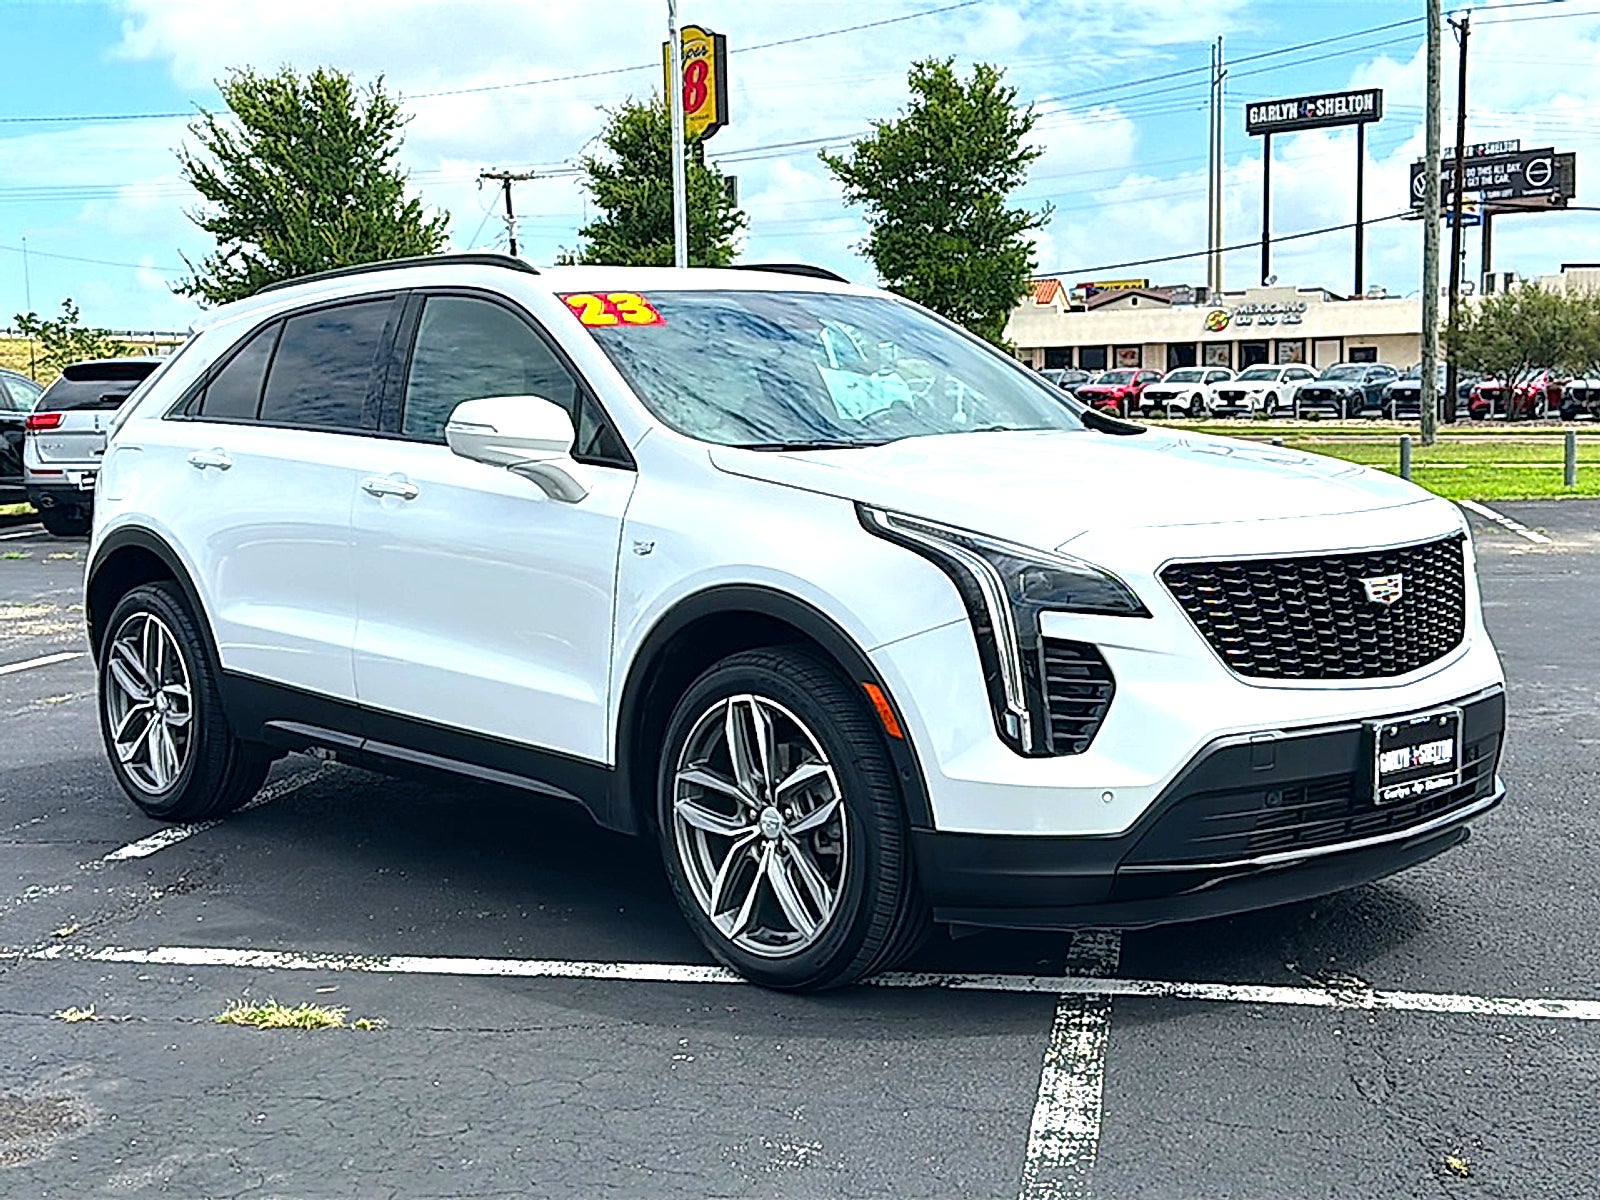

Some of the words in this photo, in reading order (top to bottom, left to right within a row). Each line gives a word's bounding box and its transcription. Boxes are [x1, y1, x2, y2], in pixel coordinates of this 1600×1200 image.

[683, 59, 709, 115] 8
[1250, 101, 1299, 124] GARLYN
[1315, 93, 1375, 117] SHELTON
[566, 293, 658, 325] 23
[1236, 302, 1307, 315] MEXICANO
